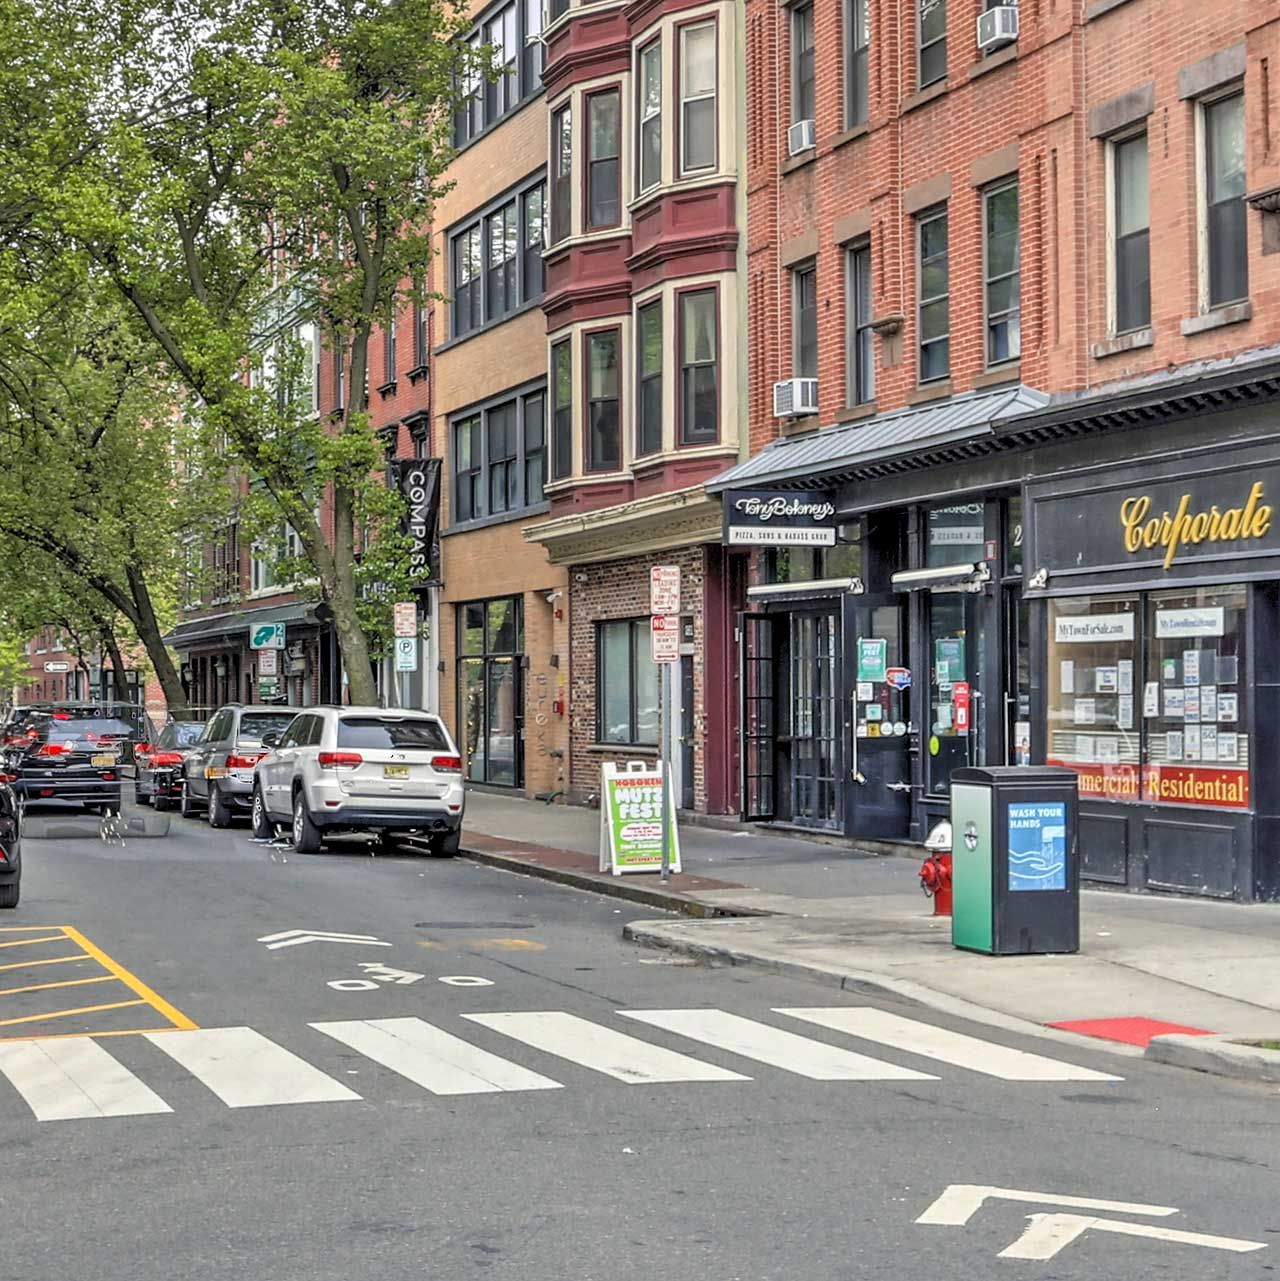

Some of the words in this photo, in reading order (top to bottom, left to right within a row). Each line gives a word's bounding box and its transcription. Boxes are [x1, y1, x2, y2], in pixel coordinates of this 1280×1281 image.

[409, 471, 426, 578] COMPASS
[1120, 480, 1271, 570] Corporate
[654, 620, 664, 629] NO
[615, 778, 663, 788] HOBOKEN
[1078, 770, 1137, 795] mercial
[1148, 771, 1245, 802] Residential
[615, 787, 662, 804] MUTZ
[619, 803, 662, 819] FEST
[1009, 809, 1036, 818] WASH
[1038, 808, 1062, 817] YOUR
[1009, 819, 1041, 829] HANDS
